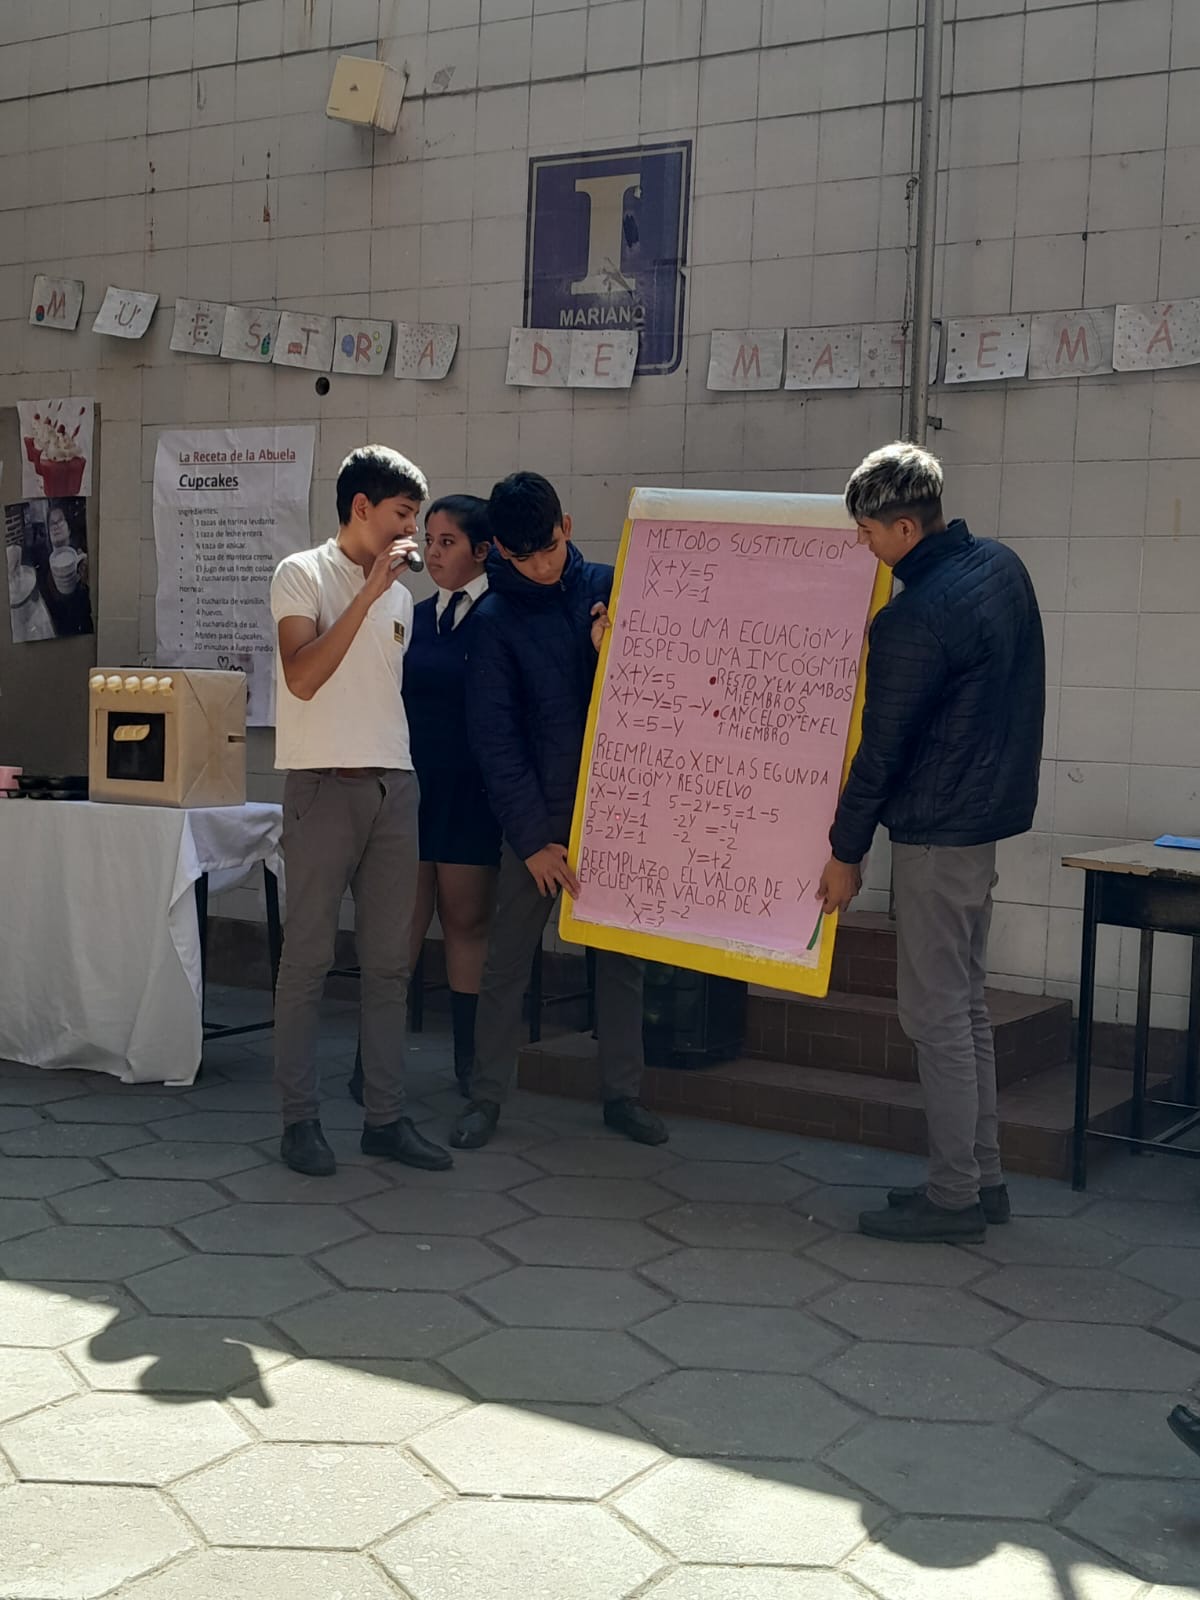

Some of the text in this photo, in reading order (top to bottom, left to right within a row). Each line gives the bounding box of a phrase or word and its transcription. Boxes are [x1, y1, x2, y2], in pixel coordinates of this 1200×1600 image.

[559, 306, 645, 326] MARIANO
[532, 342, 614, 377] DE
[179, 448, 296, 463] La Receta de la Abuela
[178, 472, 239, 490] Cupcakes
[646, 528, 721, 552] METODO
[628, 610, 681, 637] ELIJO
[622, 636, 700, 664] DESPEJO
[597, 732, 685, 770] REEMPLAZO
[678, 773, 752, 800] RESUELVO
[581, 846, 669, 881] REEMPLAZO
[703, 869, 757, 896] VALOR
[764, 878, 783, 900] DE
[673, 882, 727, 910] VALOR
[734, 895, 751, 914] DE
